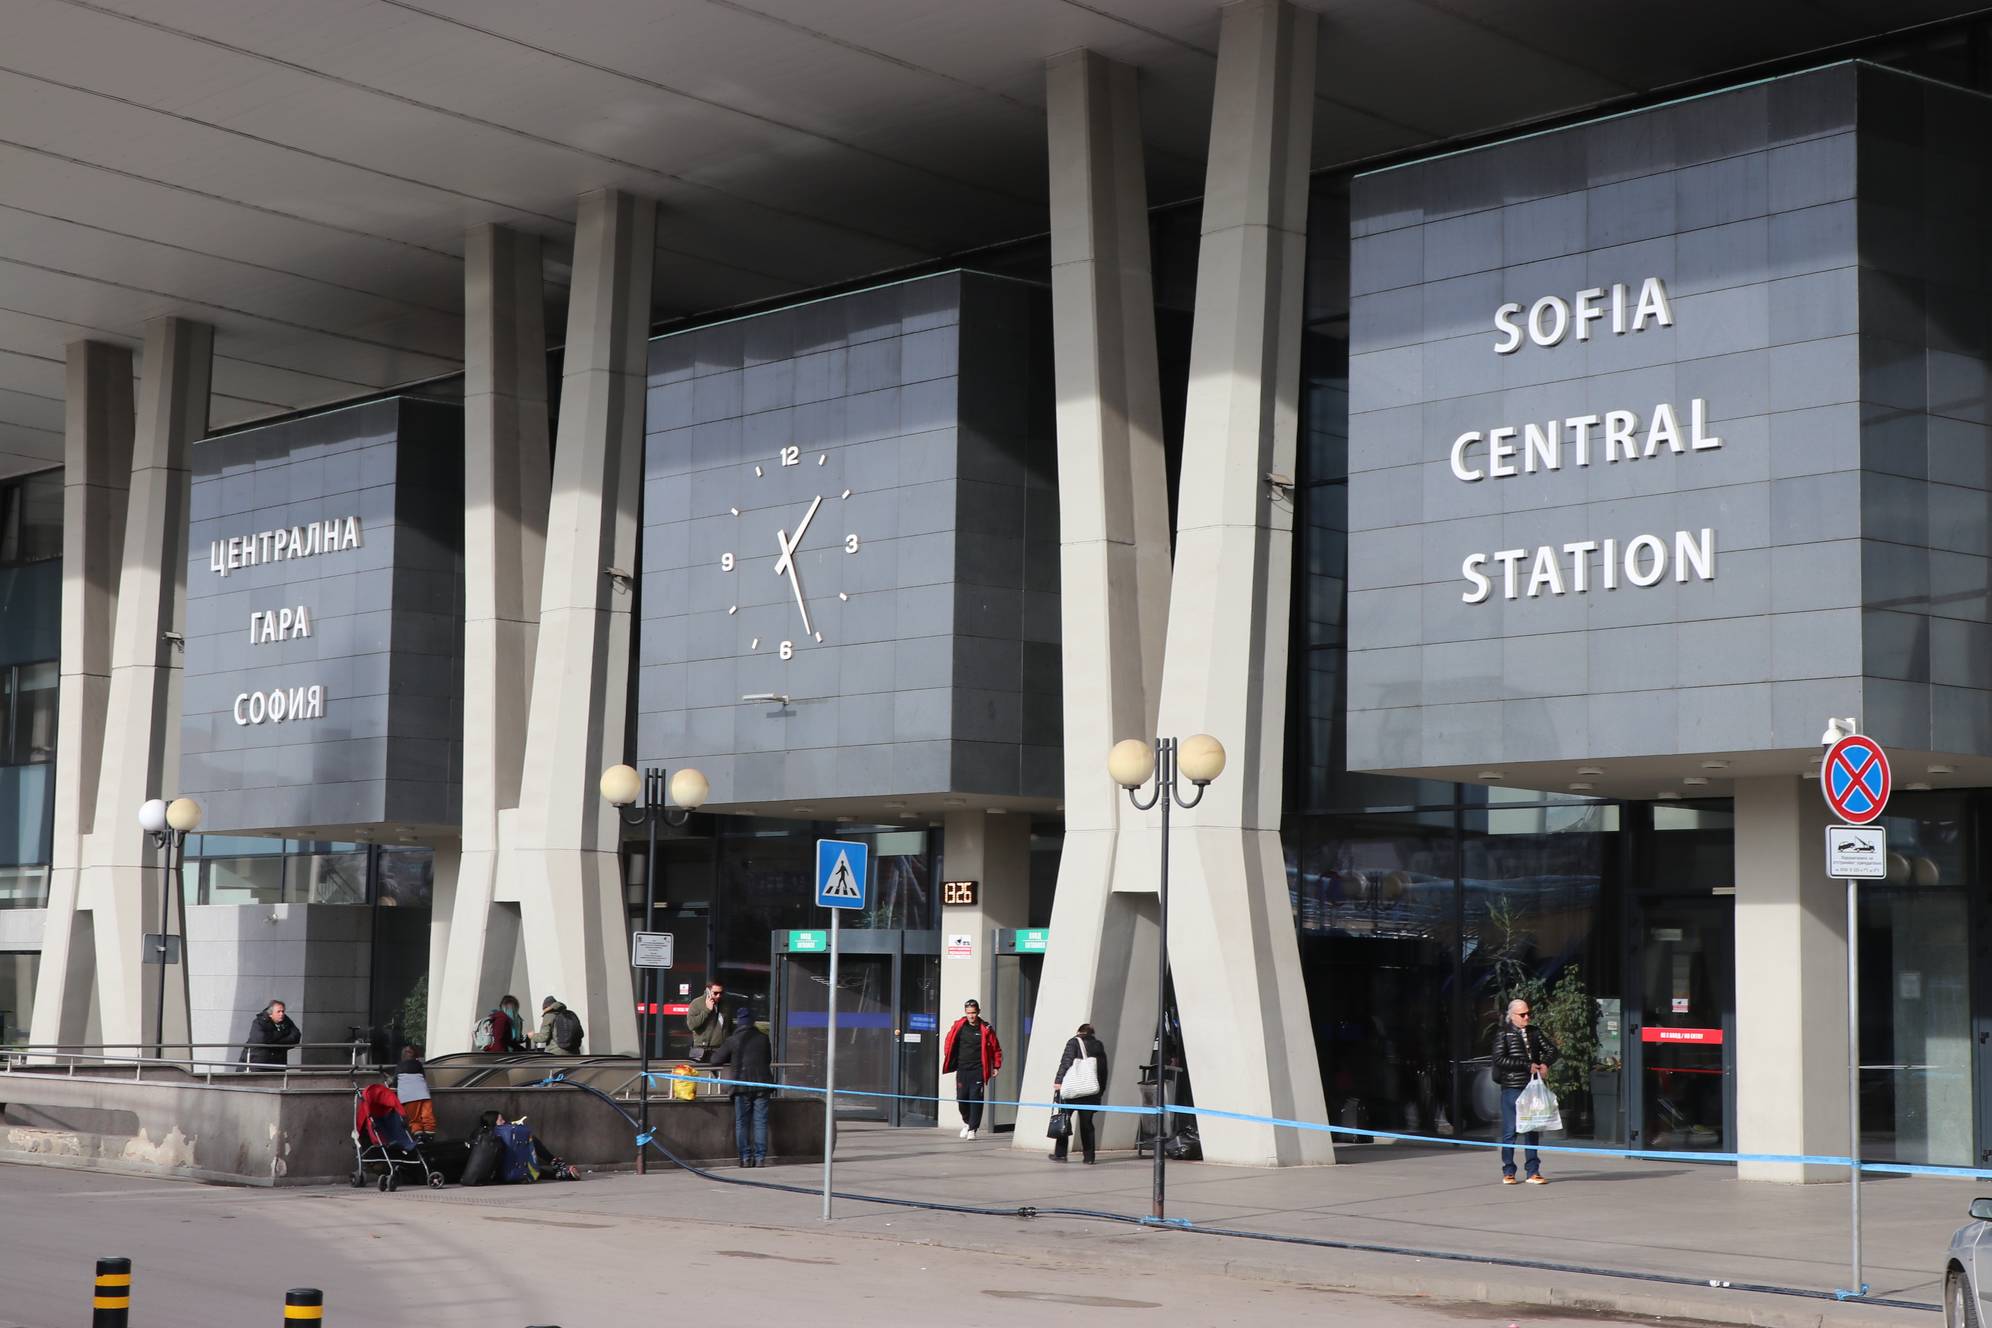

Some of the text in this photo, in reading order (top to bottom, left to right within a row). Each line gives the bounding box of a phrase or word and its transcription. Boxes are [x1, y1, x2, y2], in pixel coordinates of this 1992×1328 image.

[1493, 276, 1673, 355] SOFIA
[779, 446, 800, 467] 12
[1449, 397, 1722, 483] CENTRAL
[209, 515, 360, 577] ЦЕНТРАЛНА
[721, 552, 735, 572] 9
[845, 533, 859, 555] 3
[1460, 526, 1715, 605] STATION
[248, 604, 310, 646] ГАРА
[779, 640, 793, 661] 6
[233, 684, 323, 726] СОФИЯ
